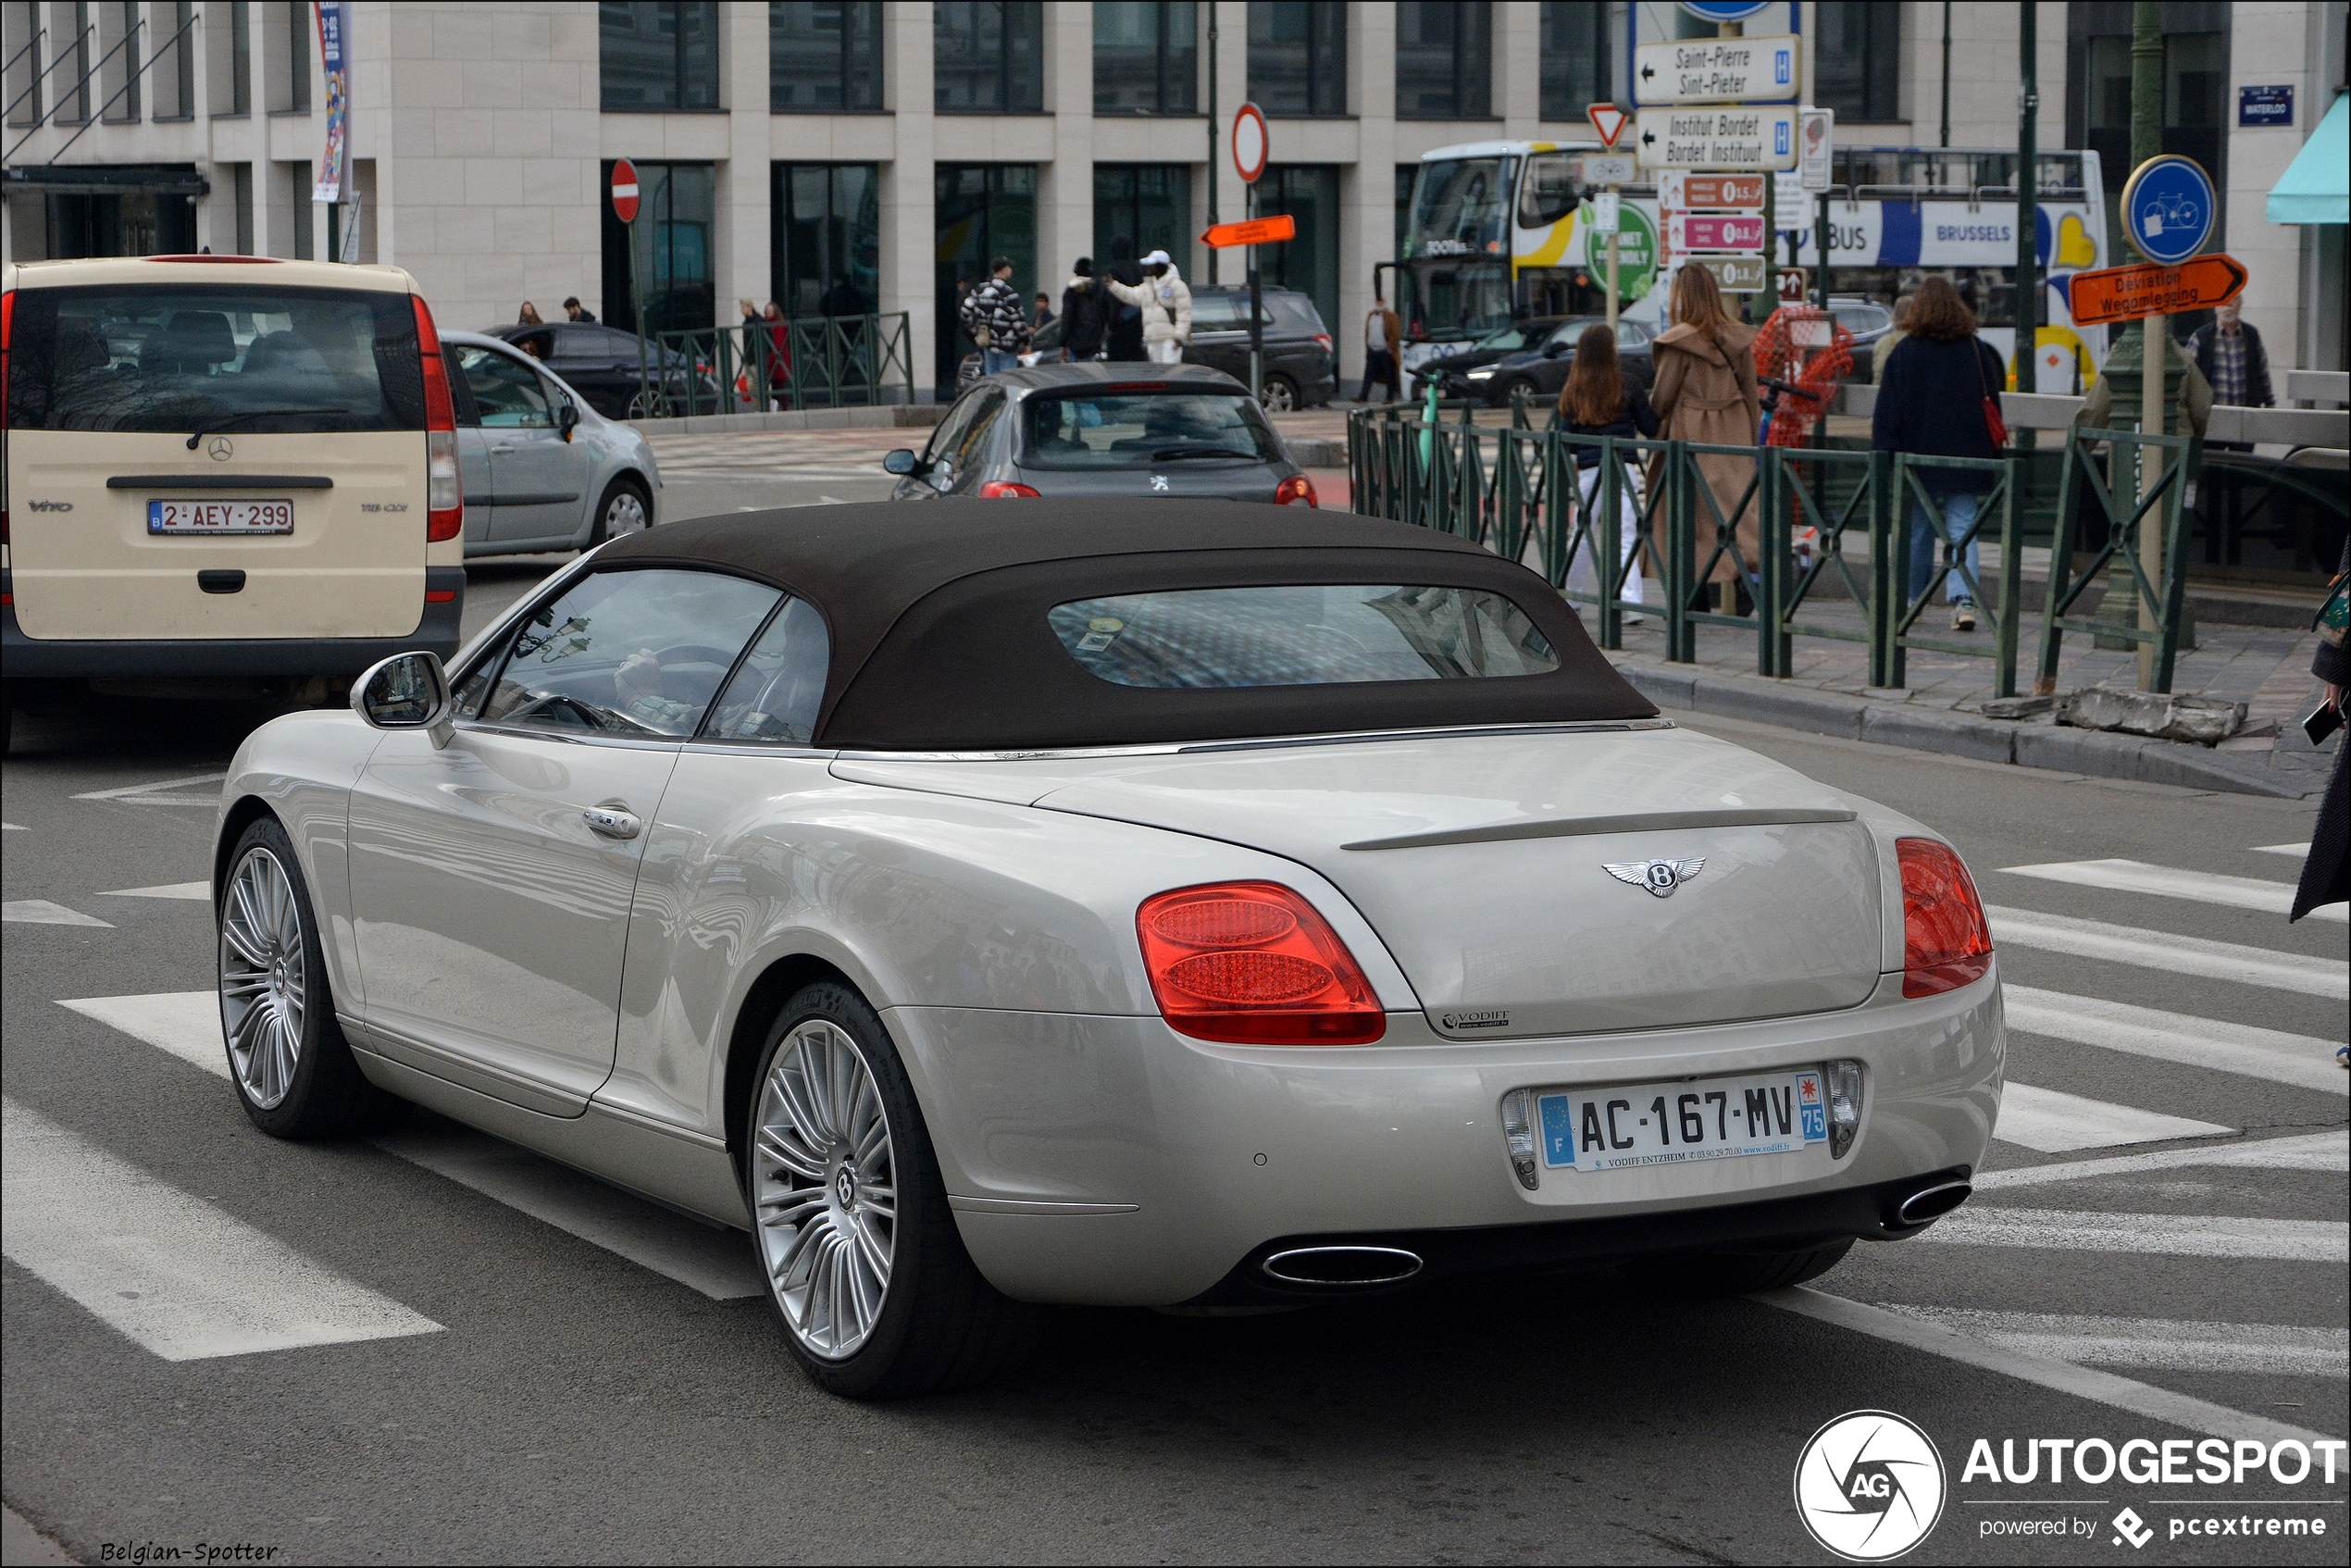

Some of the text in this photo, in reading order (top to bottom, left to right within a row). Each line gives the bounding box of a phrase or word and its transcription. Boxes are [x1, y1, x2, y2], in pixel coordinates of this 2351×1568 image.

[1675, 46, 1750, 69] Saint-Pierre
[1679, 72, 1747, 94] Sint-Pieter
[2245, 103, 2286, 115] WATERLOO
[1669, 115, 1760, 136] Institut Bordet
[1667, 141, 1761, 162] Bordet Instituut
[1937, 226, 2010, 242] BRUSSELS
[2101, 288, 2198, 314] Wegomlegging
[153, 517, 160, 527] B
[1458, 1011, 1510, 1021] VODIFF
[1460, 1020, 1508, 1028] www.vodiff.fr
[1581, 1086, 1793, 1153] AC-167-MV
[1802, 1108, 1824, 1134] 75
[1554, 1137, 1564, 1153] F
[1608, 1142, 1790, 1167] VODIFF ENTZHEIM 03.90.29.70.00 www.vodiff.fr
